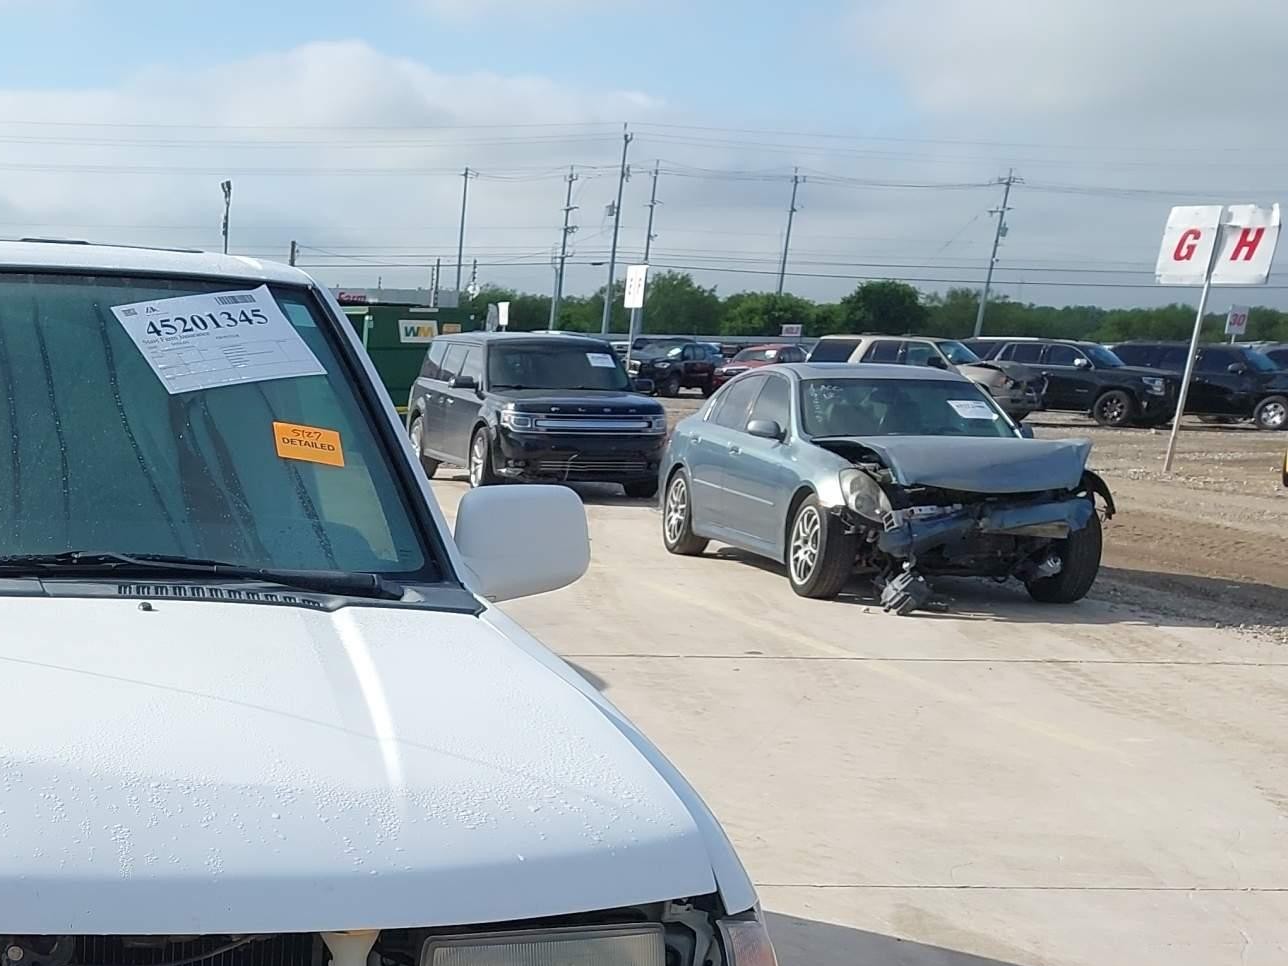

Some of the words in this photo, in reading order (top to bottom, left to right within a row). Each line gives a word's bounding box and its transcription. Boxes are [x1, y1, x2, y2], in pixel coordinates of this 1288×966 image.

[1173, 228, 1202, 261] G
[1230, 227, 1266, 261] H
[146, 308, 269, 337] 45201345
[1229, 313, 1246, 326] 30
[404, 326, 433, 337] WM
[281, 436, 336, 452] DETAILED
